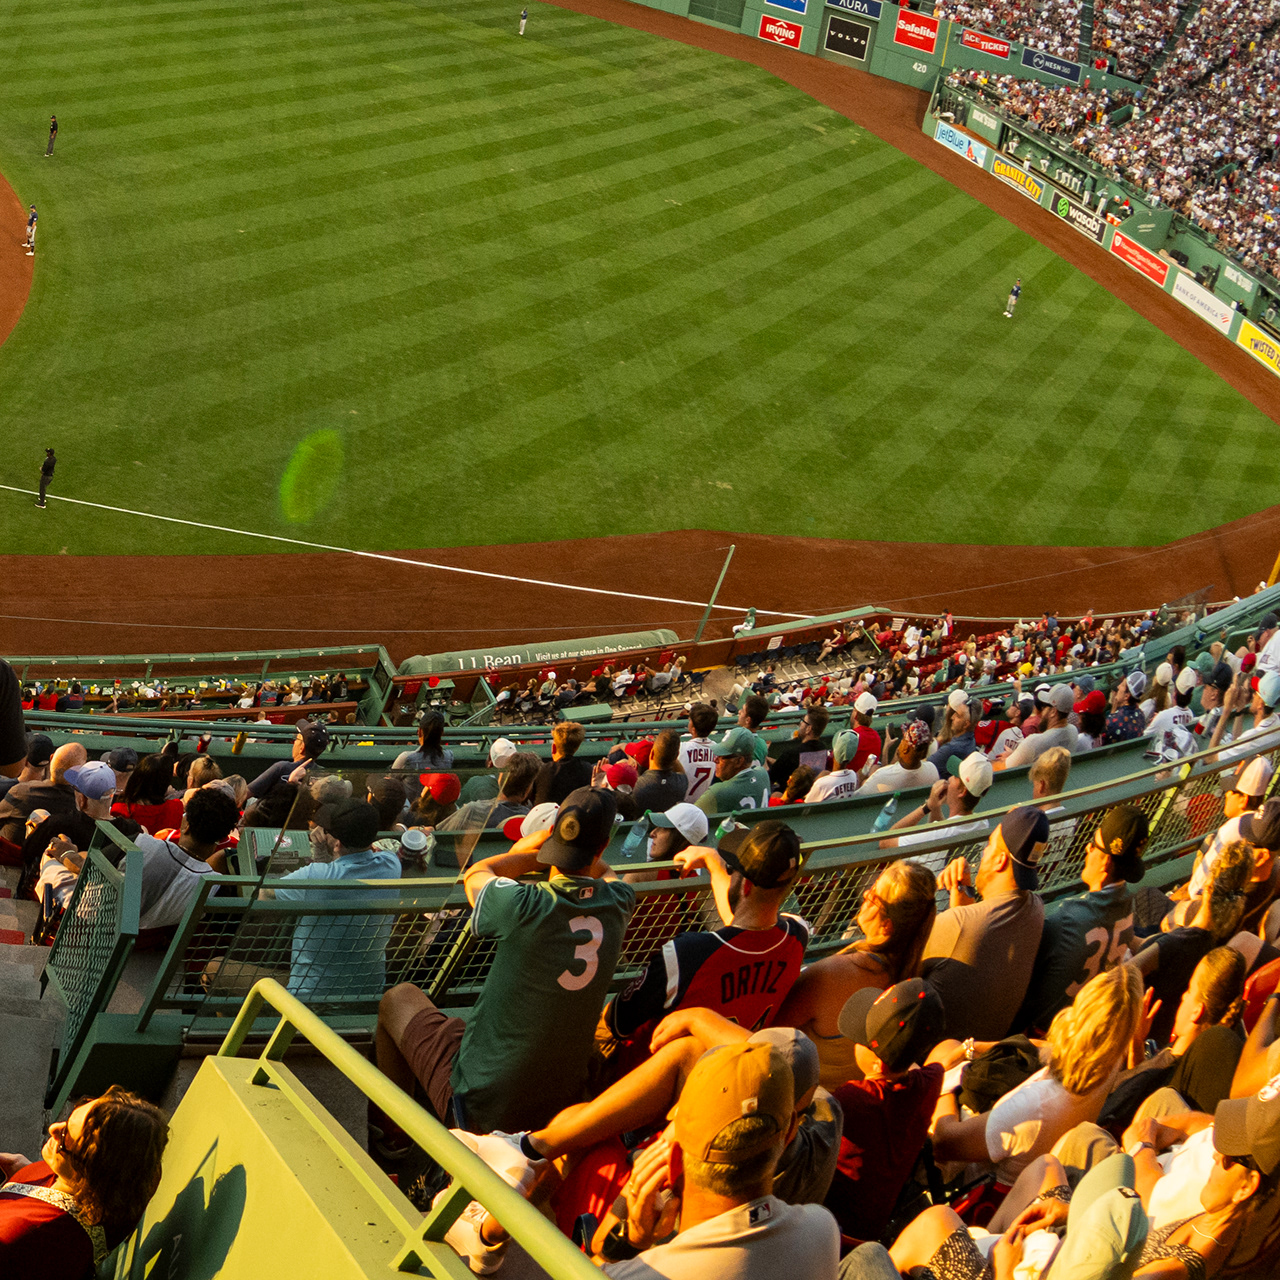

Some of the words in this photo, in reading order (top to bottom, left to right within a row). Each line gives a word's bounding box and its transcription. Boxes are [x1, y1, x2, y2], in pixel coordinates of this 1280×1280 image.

[766, 23, 795, 40] IRVING
[830, 30, 866, 46] VOLVO
[898, 19, 936, 39] Safelite
[964, 33, 981, 44] ACE
[980, 41, 1009, 52] TICKET
[912, 62, 928, 73] 420
[1044, 61, 1061, 70] NESN
[1061, 66, 1071, 74] 360
[937, 126, 964, 150] jetBlue
[994, 160, 1026, 187] GRANITE
[1025, 179, 1042, 201] CITY
[1069, 206, 1101, 233] wasabi
[1175, 284, 1190, 298] BANK
[1190, 294, 1197, 304] OF
[1196, 297, 1219, 318] AMERICA
[690, 767, 712, 796] 7
[556, 915, 604, 992] 3
[720, 960, 788, 1004] ORTIZ
